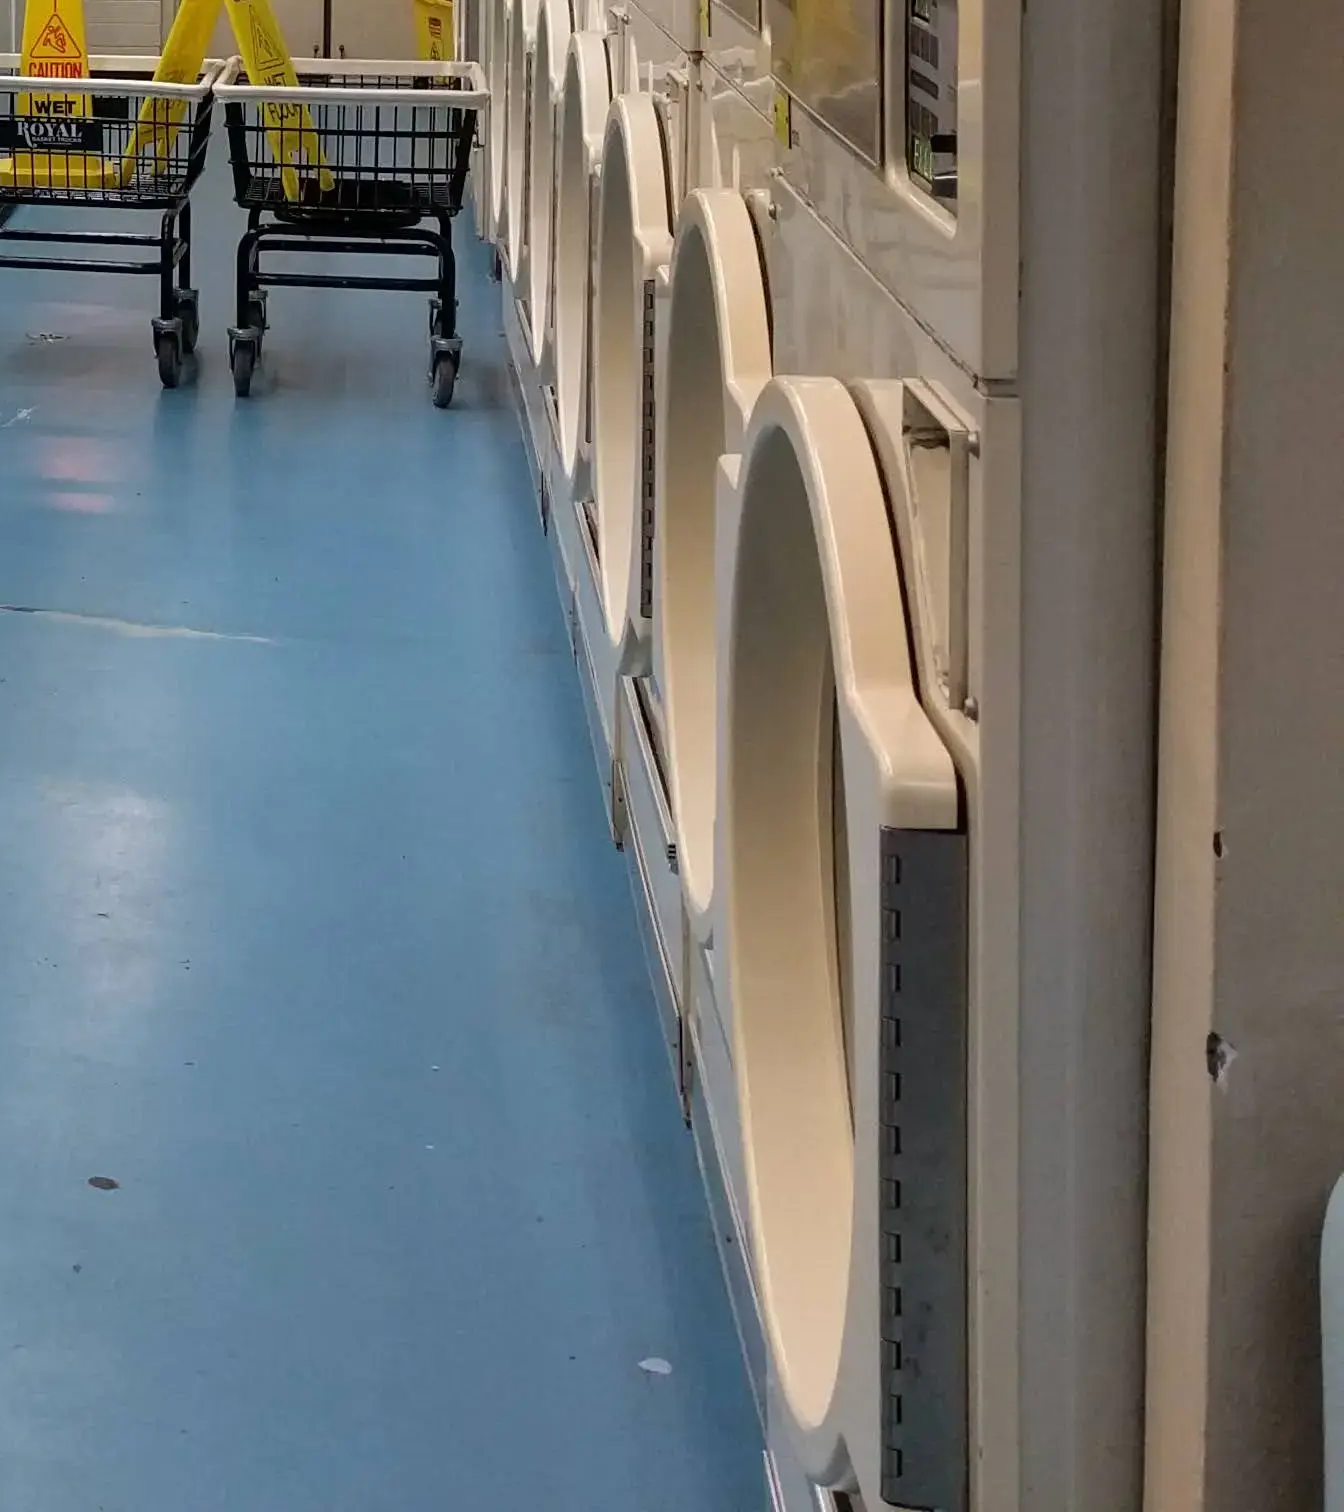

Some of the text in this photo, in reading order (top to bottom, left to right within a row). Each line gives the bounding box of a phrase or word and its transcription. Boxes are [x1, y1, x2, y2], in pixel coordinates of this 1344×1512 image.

[29, 61, 82, 79] CAUTION
[263, 72, 287, 87] WET
[34, 100, 77, 115] WET
[16, 121, 83, 148] ROYAL
